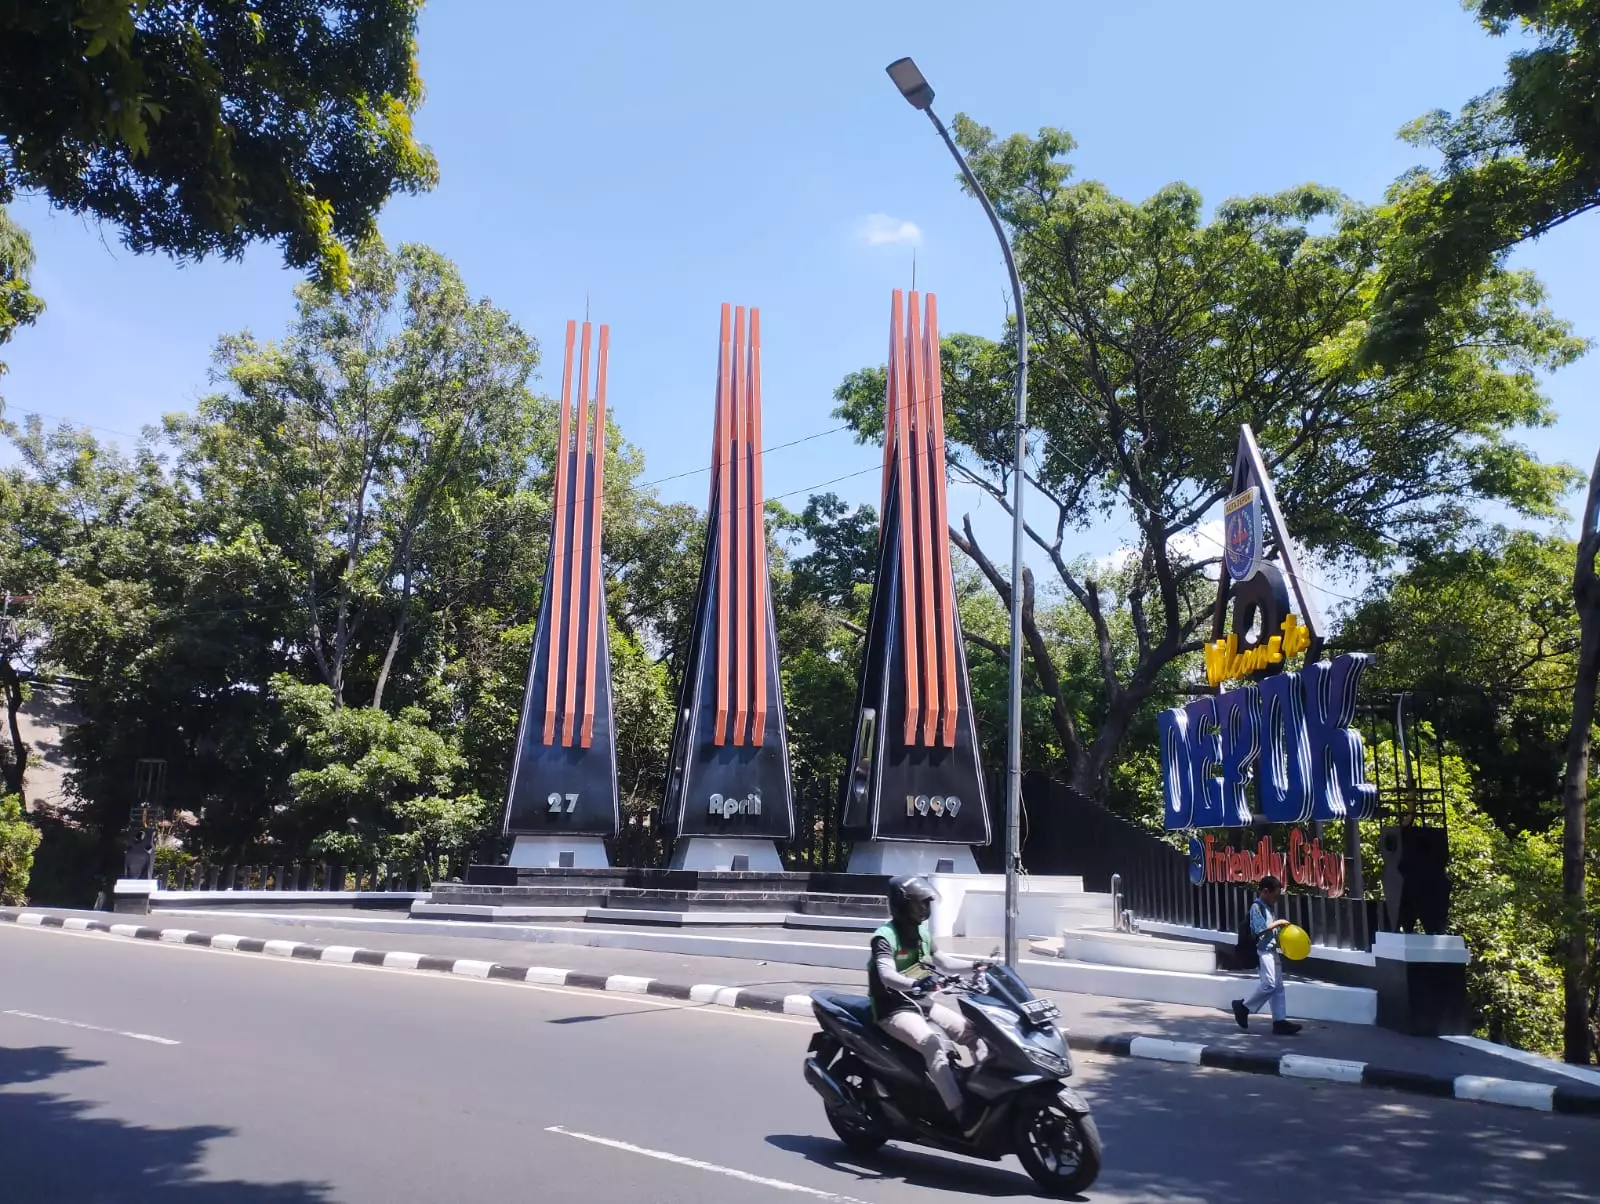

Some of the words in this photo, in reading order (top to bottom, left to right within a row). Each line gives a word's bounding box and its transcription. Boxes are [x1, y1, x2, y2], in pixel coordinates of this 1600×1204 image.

[1157, 653, 1377, 831] DEPOK
[547, 792, 580, 813] 27
[708, 793, 762, 819] April
[906, 795, 962, 818] 1999
[1204, 834, 1288, 894] Friendly
[1289, 827, 1345, 899] City
